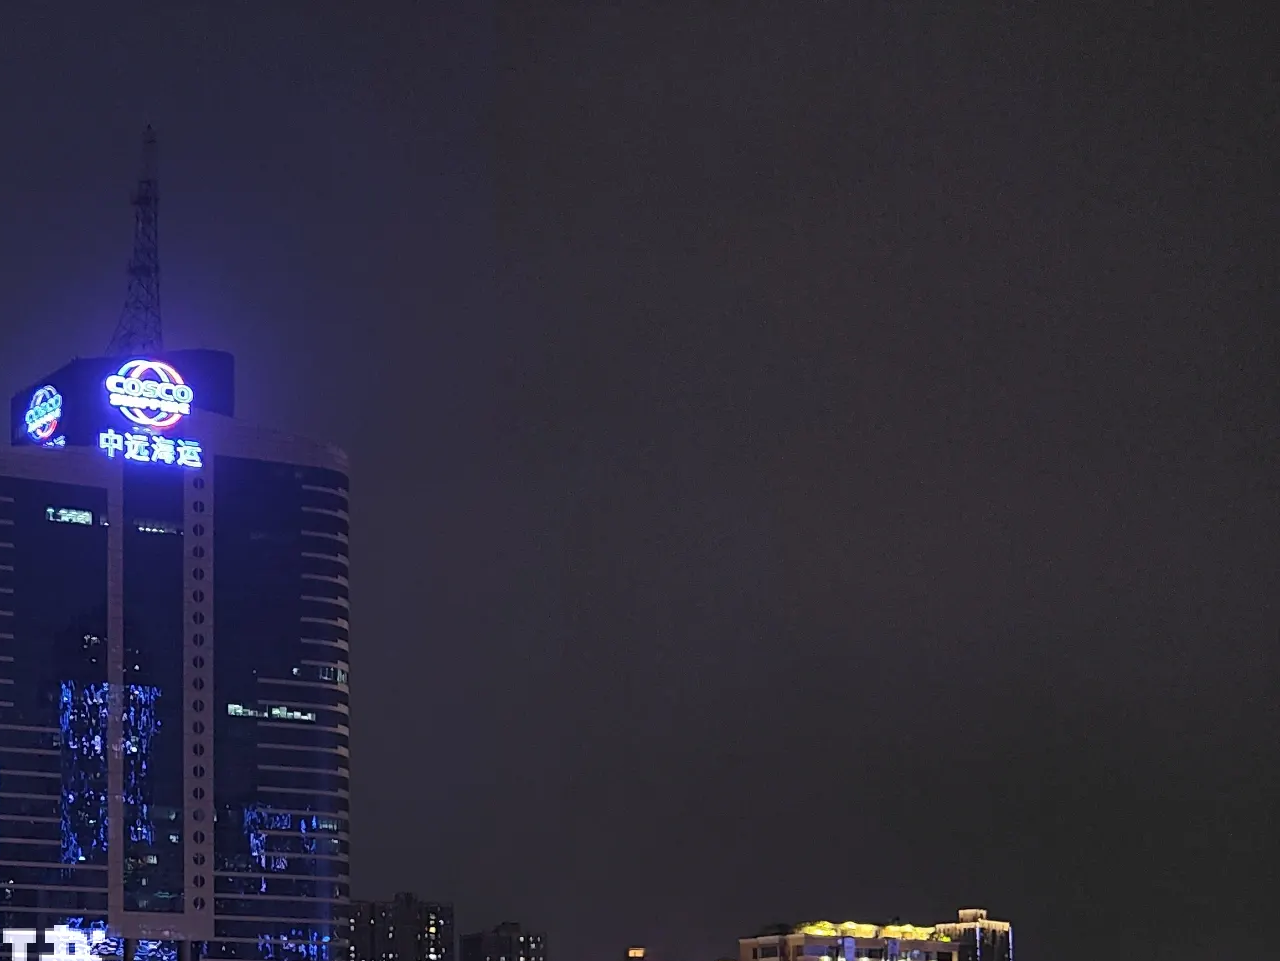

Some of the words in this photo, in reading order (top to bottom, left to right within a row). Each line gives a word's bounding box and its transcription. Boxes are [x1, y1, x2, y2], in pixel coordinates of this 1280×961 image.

[106, 375, 193, 403] COSCO
[99, 428, 202, 468] 中远海运
